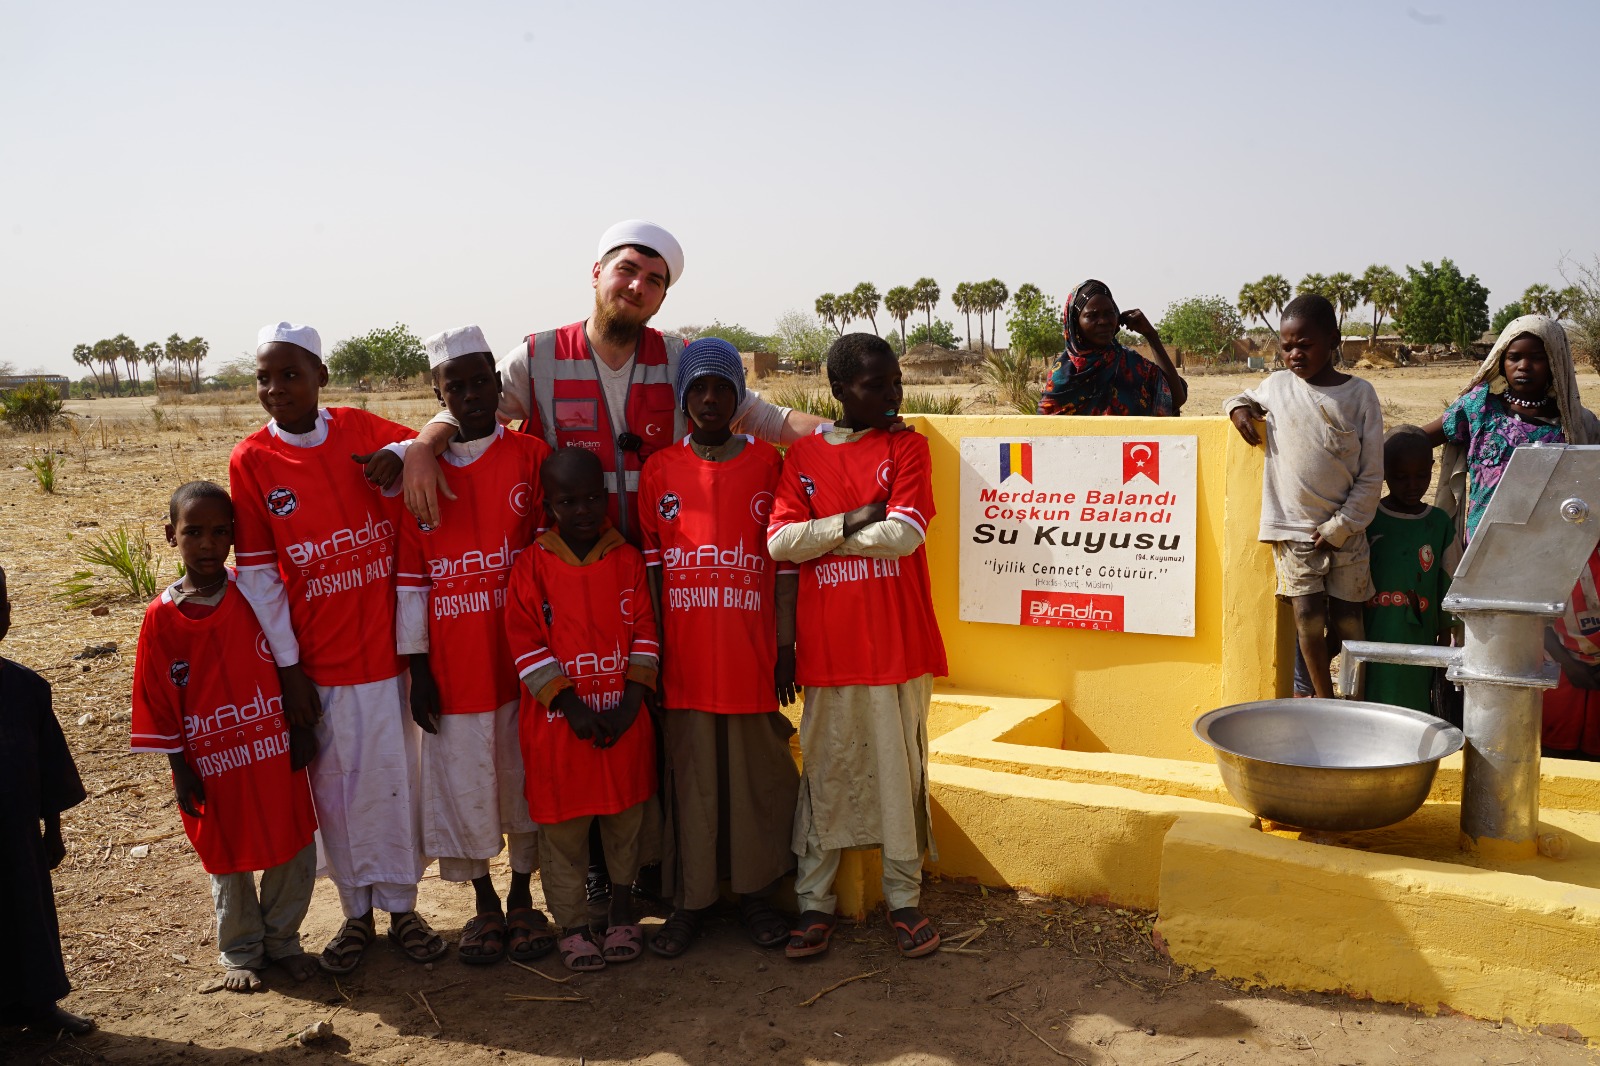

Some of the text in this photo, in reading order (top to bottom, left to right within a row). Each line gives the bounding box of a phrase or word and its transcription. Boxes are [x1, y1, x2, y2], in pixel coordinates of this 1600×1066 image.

[979, 488, 1177, 506] Merdane Balandı
[984, 505, 1172, 524] Coşkun Balandı
[972, 523, 1181, 554] Su Kuyusu
[1135, 553, 1185, 563] (94. Kuyumuz)
[1032, 562, 1092, 577] Cennet'e
